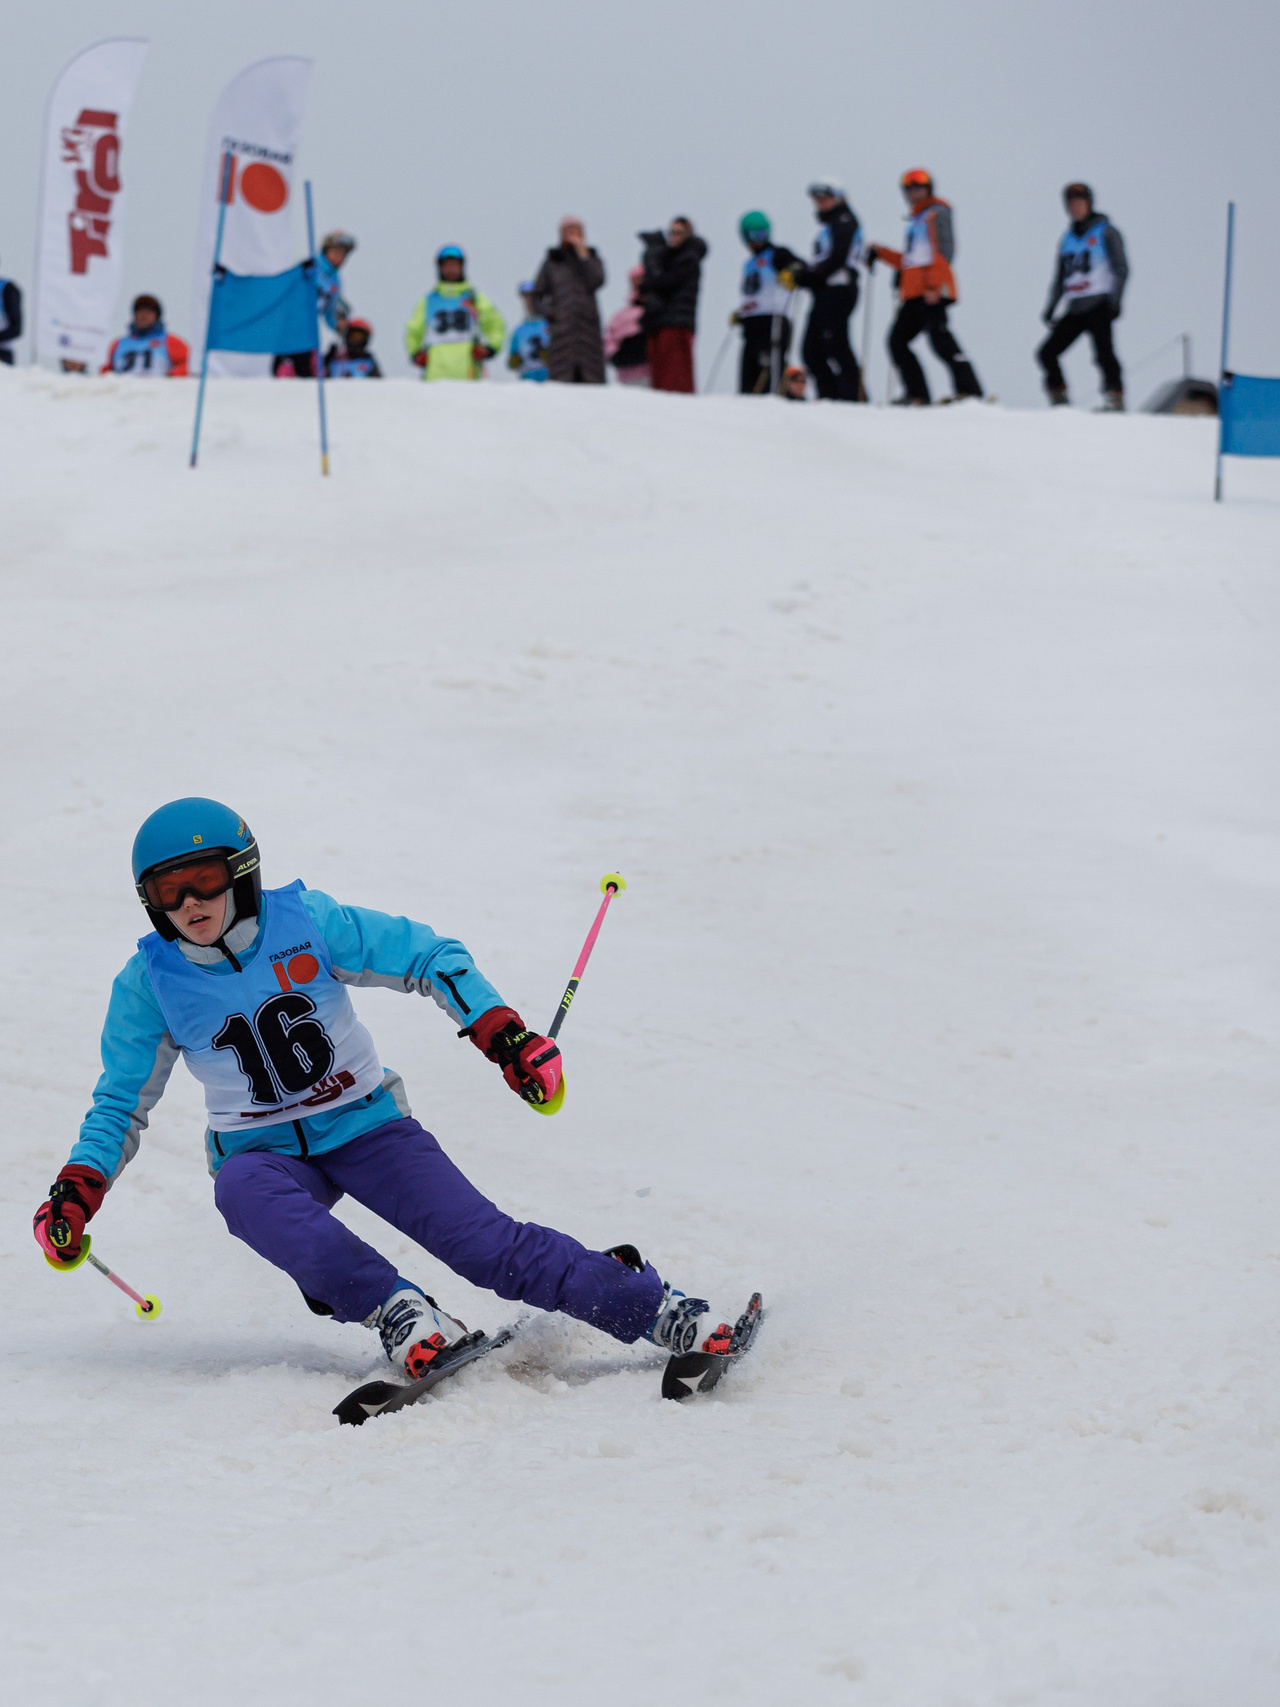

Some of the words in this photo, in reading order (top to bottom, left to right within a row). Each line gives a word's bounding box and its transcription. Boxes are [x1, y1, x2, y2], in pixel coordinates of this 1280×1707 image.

[269, 941, 312, 963] ГАЗОВАЯ
[211, 992, 335, 1105] 16
[311, 1074, 338, 1095] SKI
